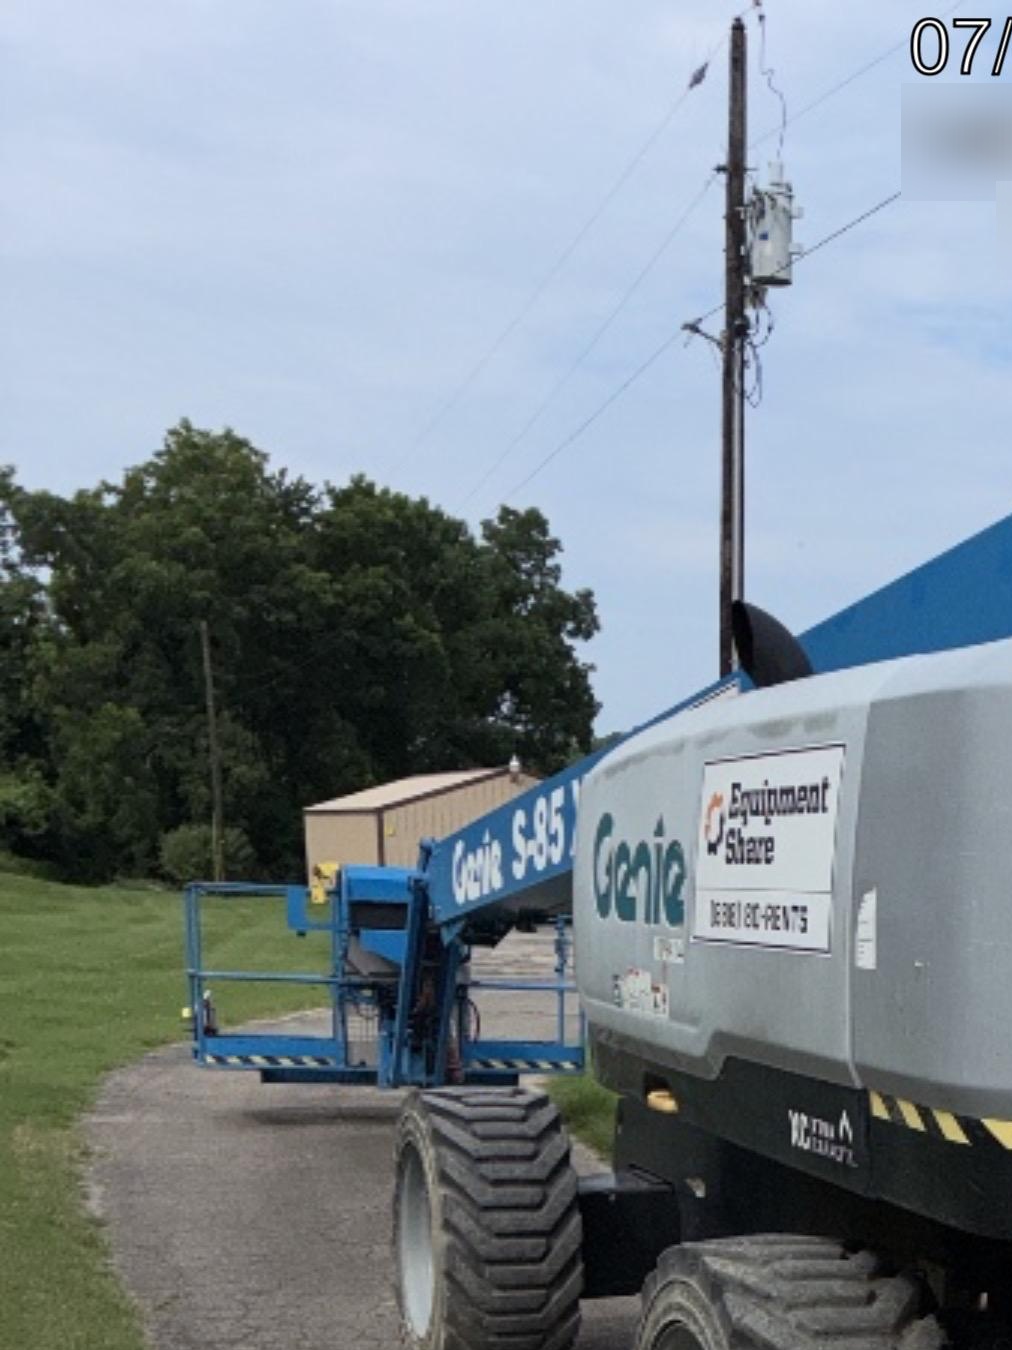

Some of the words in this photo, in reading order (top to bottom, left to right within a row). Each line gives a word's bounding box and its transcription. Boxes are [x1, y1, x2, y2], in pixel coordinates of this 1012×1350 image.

[728, 777, 830, 825] Equipment
[452, 829, 503, 905] Genie
[511, 786, 566, 880] S-85
[593, 812, 685, 928] Genie
[724, 828, 776, 865] Share
